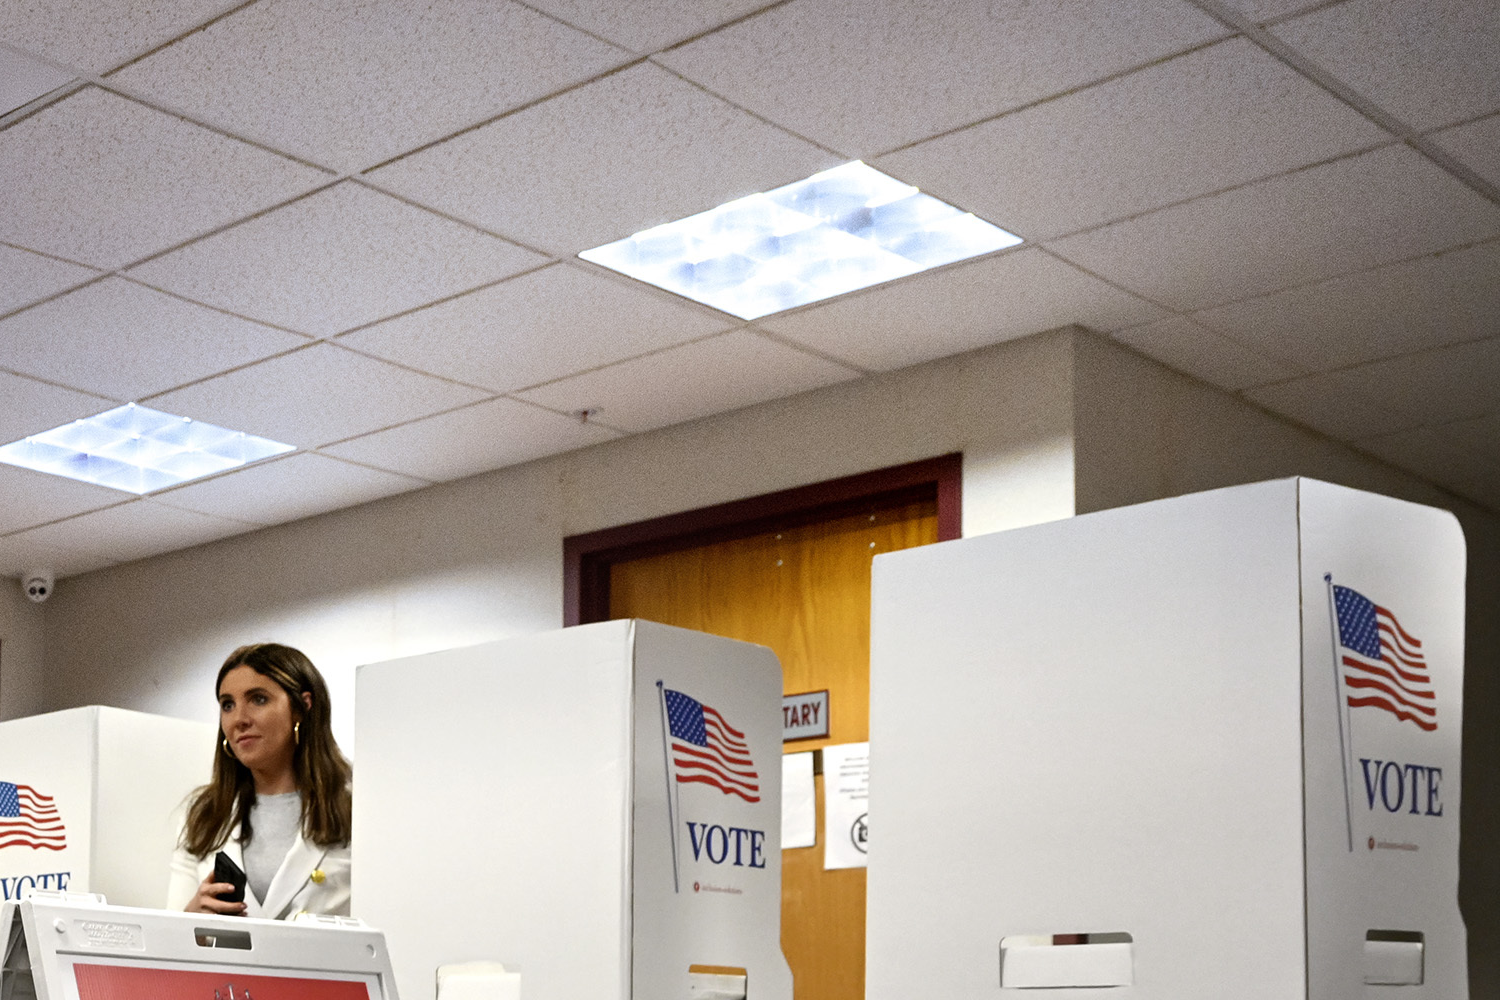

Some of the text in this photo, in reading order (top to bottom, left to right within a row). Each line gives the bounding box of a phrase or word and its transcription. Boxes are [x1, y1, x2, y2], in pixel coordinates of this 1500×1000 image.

[782, 702, 821, 729] TARY
[1360, 759, 1443, 817] VOTE
[686, 822, 766, 868] VOTE
[1, 872, 71, 900] VOTE
